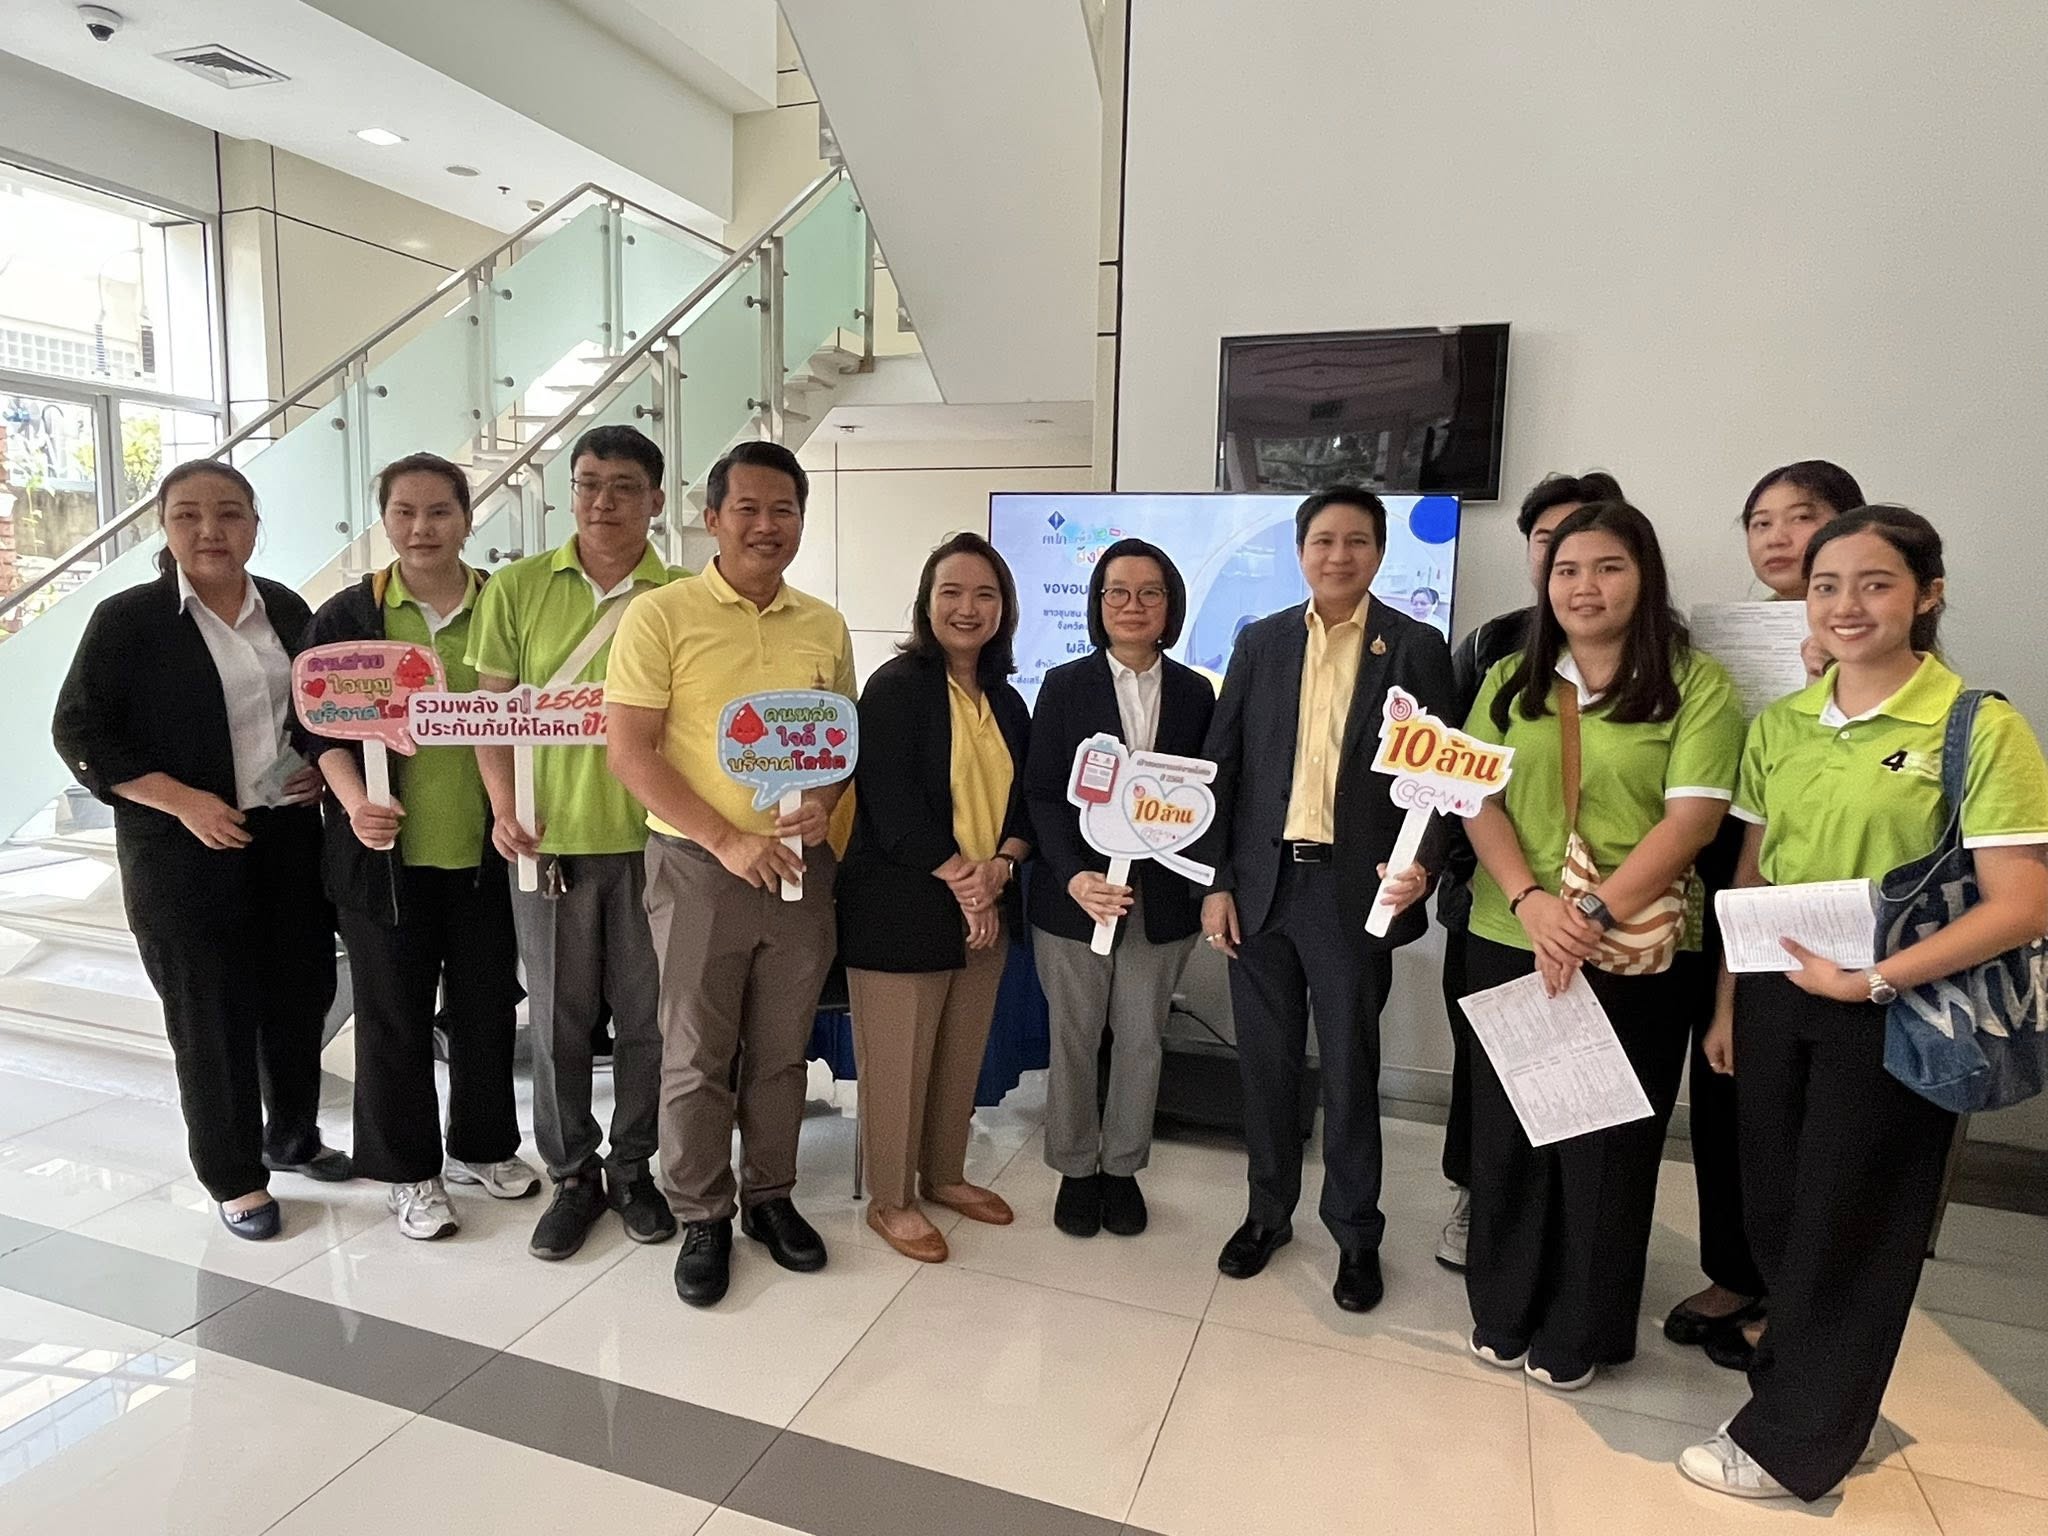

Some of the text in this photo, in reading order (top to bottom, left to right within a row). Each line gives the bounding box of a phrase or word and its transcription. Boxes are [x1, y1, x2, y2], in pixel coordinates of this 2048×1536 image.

[327, 673, 393, 701] ใจบุญ
[416, 687, 604, 714] รวมพลัง 2568
[764, 698, 838, 723] คนหล่อ
[776, 722, 817, 747] ใจดี
[727, 747, 846, 773] บริจาคโลหิต
[1388, 725, 1500, 782] 10 ล้าน
[1135, 799, 1193, 823] 10 ล้าน
